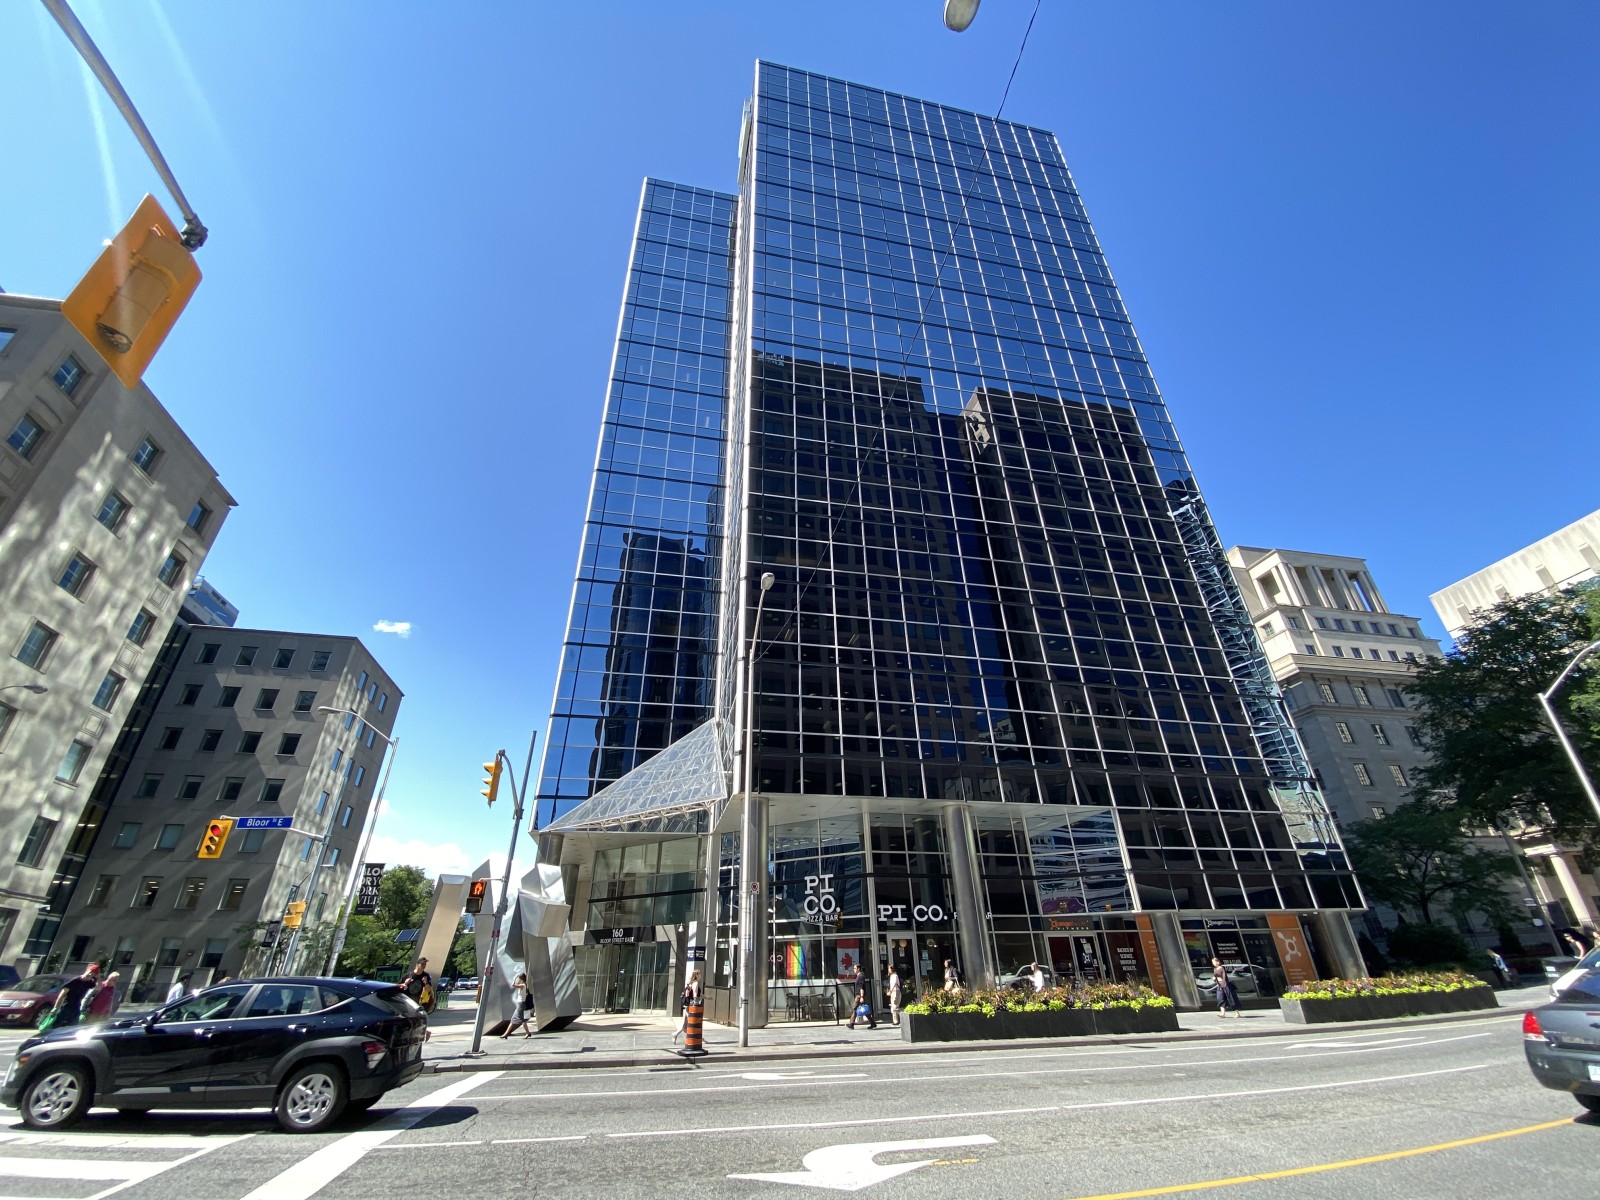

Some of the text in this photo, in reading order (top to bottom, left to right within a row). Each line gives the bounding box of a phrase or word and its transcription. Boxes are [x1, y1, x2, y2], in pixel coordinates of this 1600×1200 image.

[246, 818, 270, 827] Bloor
[277, 818, 284, 827] E
[804, 873, 834, 894] PI
[803, 894, 841, 915] CO.
[825, 914, 839, 922] BAR
[877, 904, 908, 922] PI
[913, 904, 949, 922] CO.
[612, 928, 624, 938] 160
